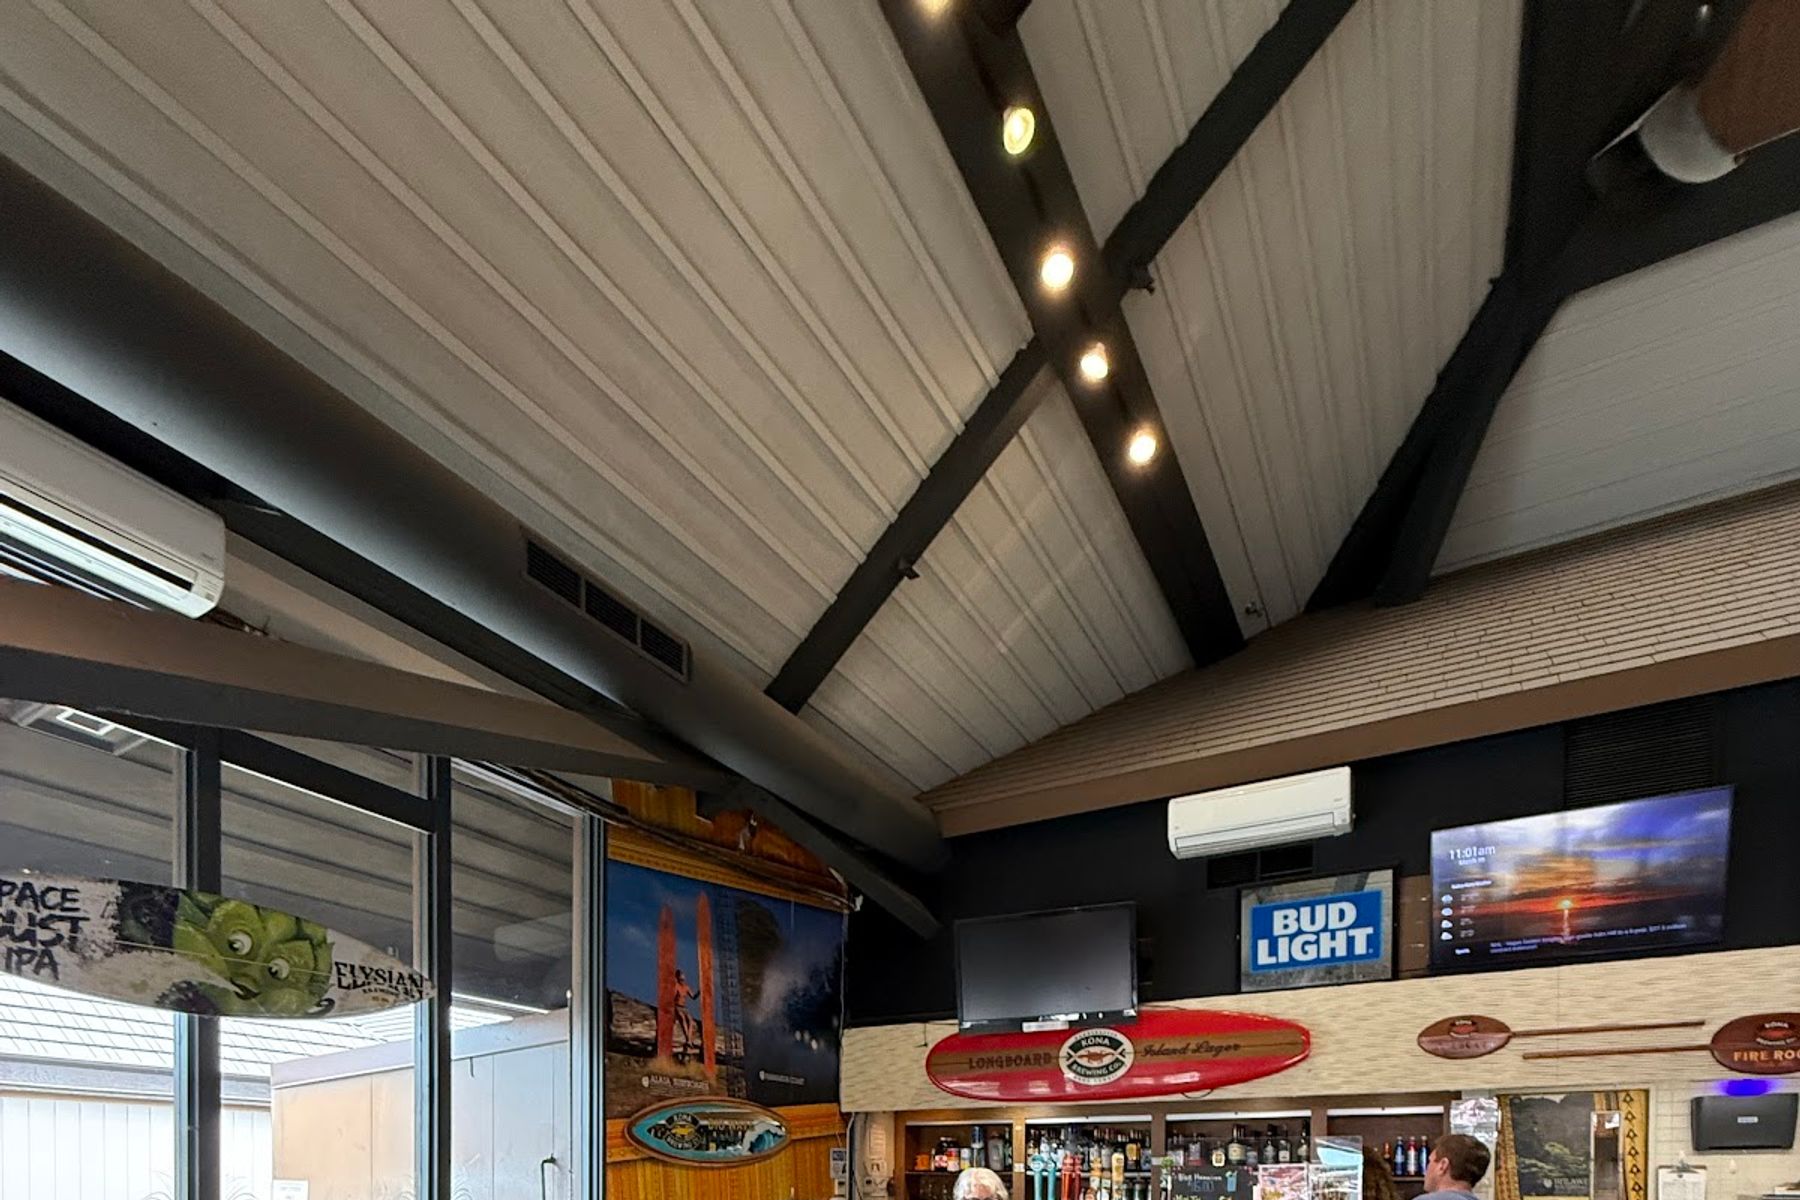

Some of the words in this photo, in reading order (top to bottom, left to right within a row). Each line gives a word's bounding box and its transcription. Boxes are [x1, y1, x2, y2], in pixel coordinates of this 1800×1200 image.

[1449, 845, 1496, 860] 11:01am
[1273, 901, 1357, 937] BUD
[1257, 926, 1374, 966] LIGHT
[5, 945, 60, 981] IPA
[334, 961, 424, 990] ELYSIAN
[1081, 1036, 1110, 1047] KONA
[1141, 1043, 1189, 1058] Island
[1192, 1041, 1241, 1058] Lager
[968, 1053, 1051, 1070] LONGBOARD
[1733, 1050, 1769, 1062] FIRE
[1072, 1063, 1108, 1077] BREWING
